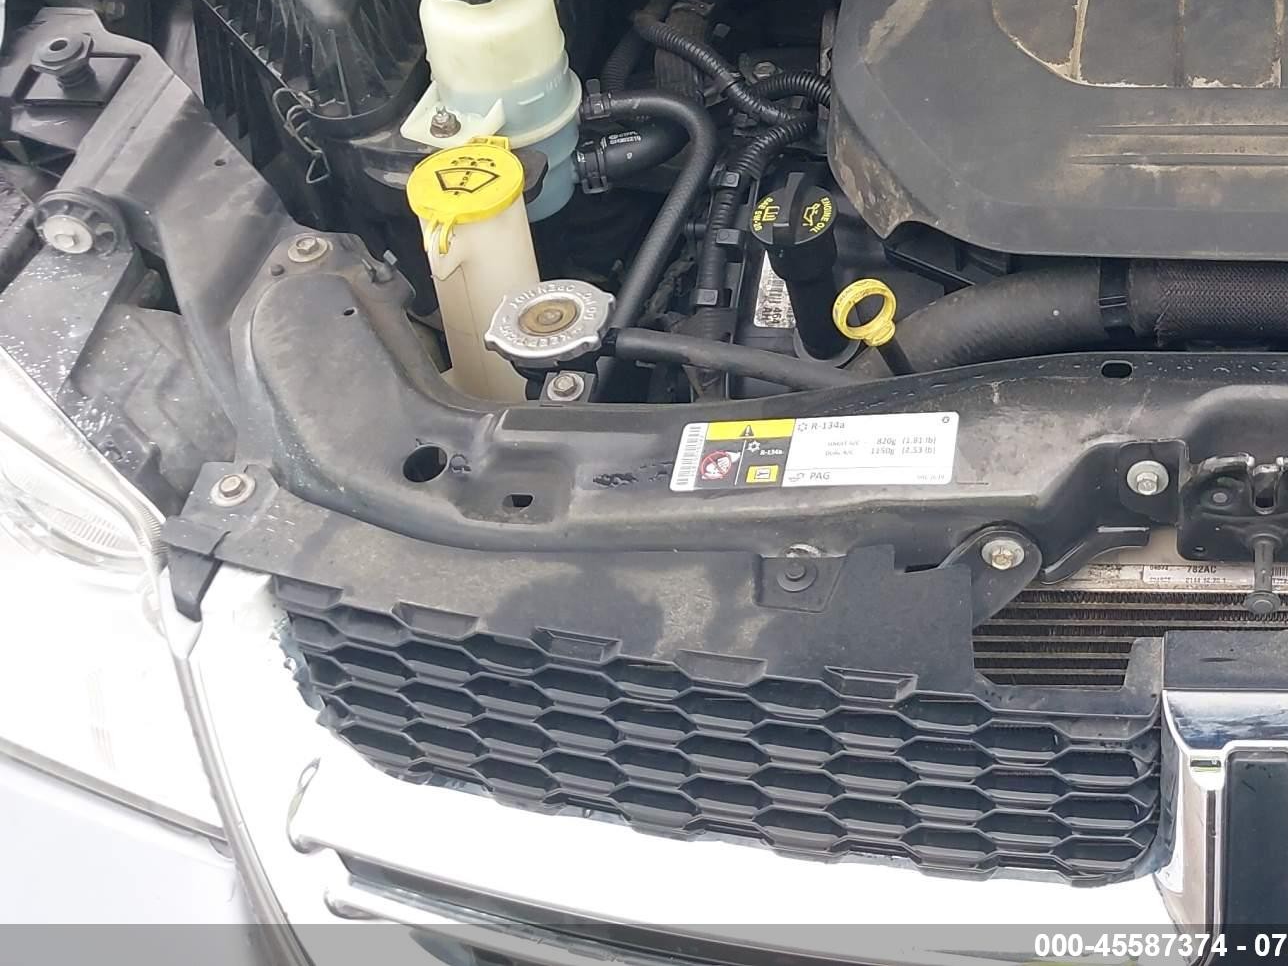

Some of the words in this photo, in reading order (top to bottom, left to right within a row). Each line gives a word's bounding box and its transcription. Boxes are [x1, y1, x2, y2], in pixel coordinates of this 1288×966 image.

[820, 196, 834, 222] ENGINE
[809, 222, 826, 234] OIL
[811, 421, 846, 430] R-134a
[809, 471, 831, 480] PAG
